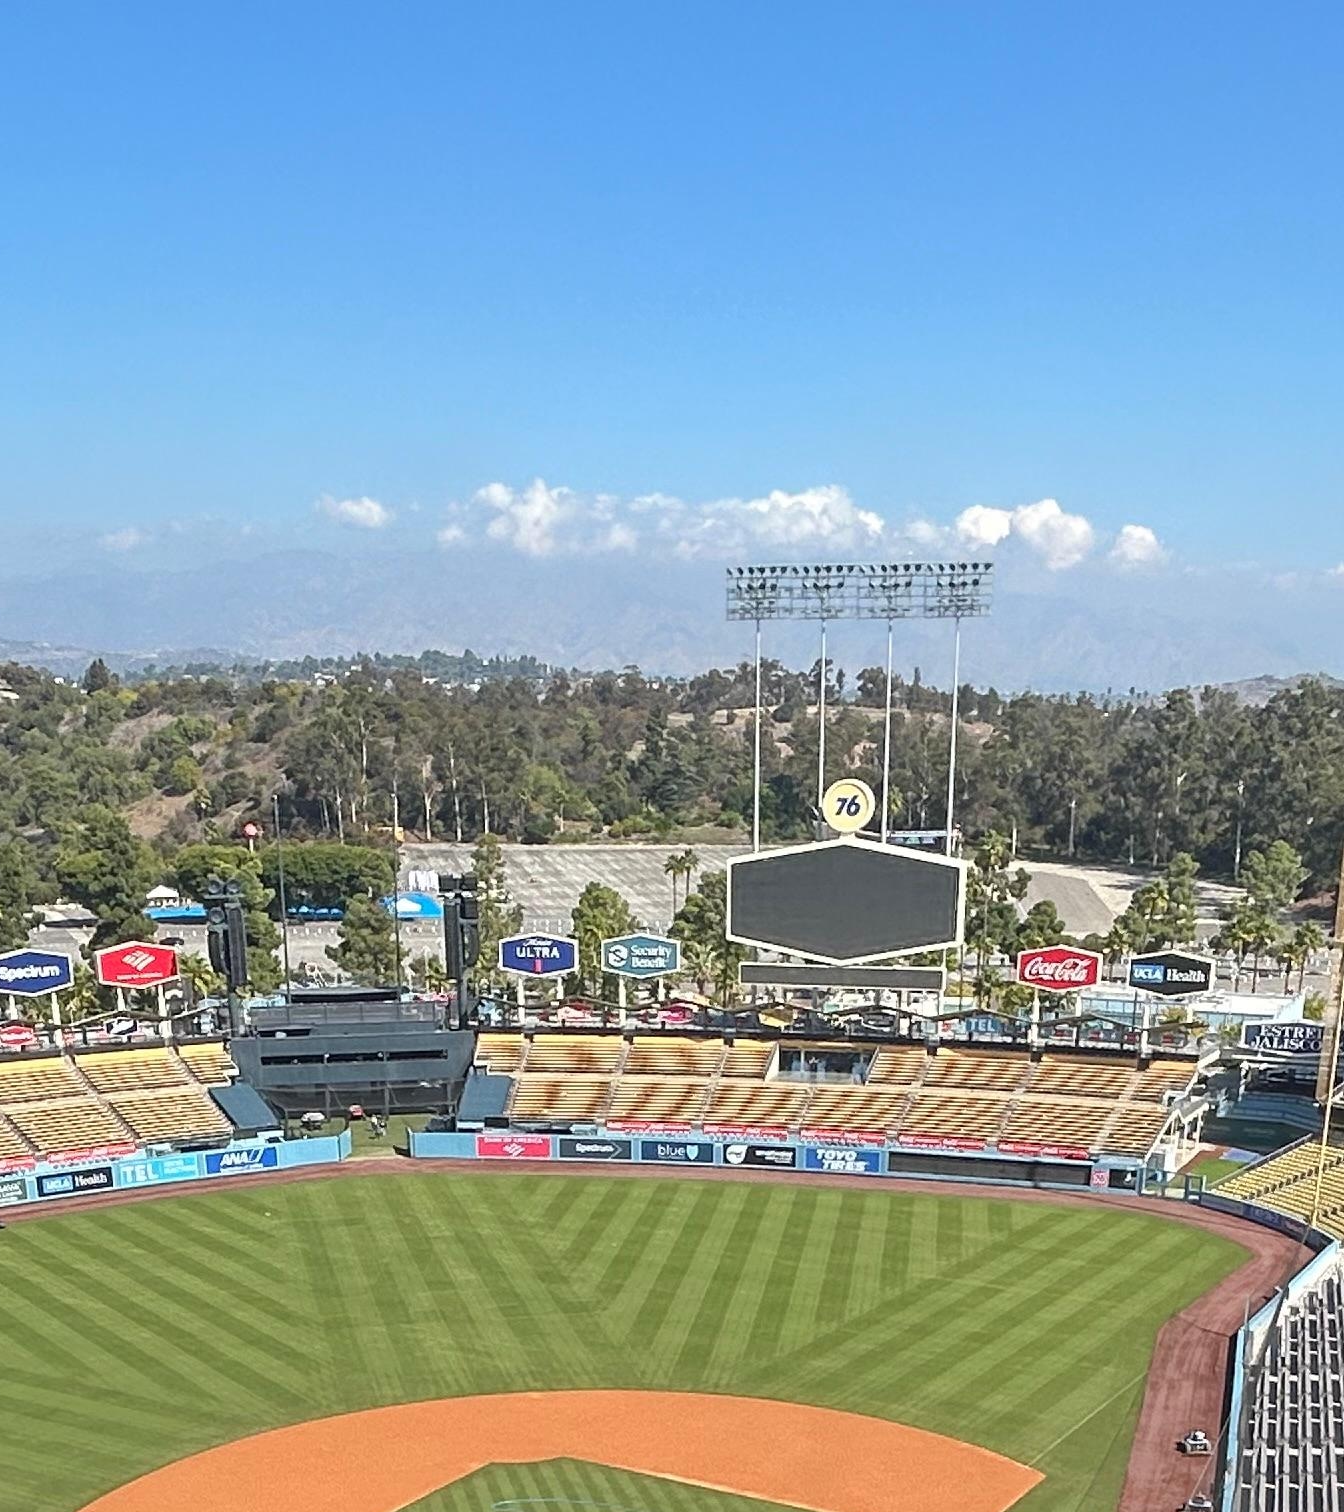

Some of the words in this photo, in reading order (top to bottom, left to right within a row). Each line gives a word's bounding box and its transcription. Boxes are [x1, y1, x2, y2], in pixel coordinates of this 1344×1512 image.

[835, 795, 861, 816] 76
[516, 946, 560, 959] ULTRA
[630, 944, 672, 958] Security
[631, 956, 669, 969] Benefit
[1023, 956, 1093, 982] Coca-Cola
[1133, 968, 1163, 981] UCLA
[1166, 967, 1206, 983] Health
[1251, 1035, 1323, 1051] JALISCO
[575, 1143, 614, 1153] Spectrum
[657, 1144, 685, 1156] blue
[816, 1149, 858, 1161] TOYO
[220, 1152, 249, 1167] ANA
[822, 1160, 869, 1172] TIRES
[74, 1172, 108, 1187] Health
[120, 1163, 159, 1184] TEL
